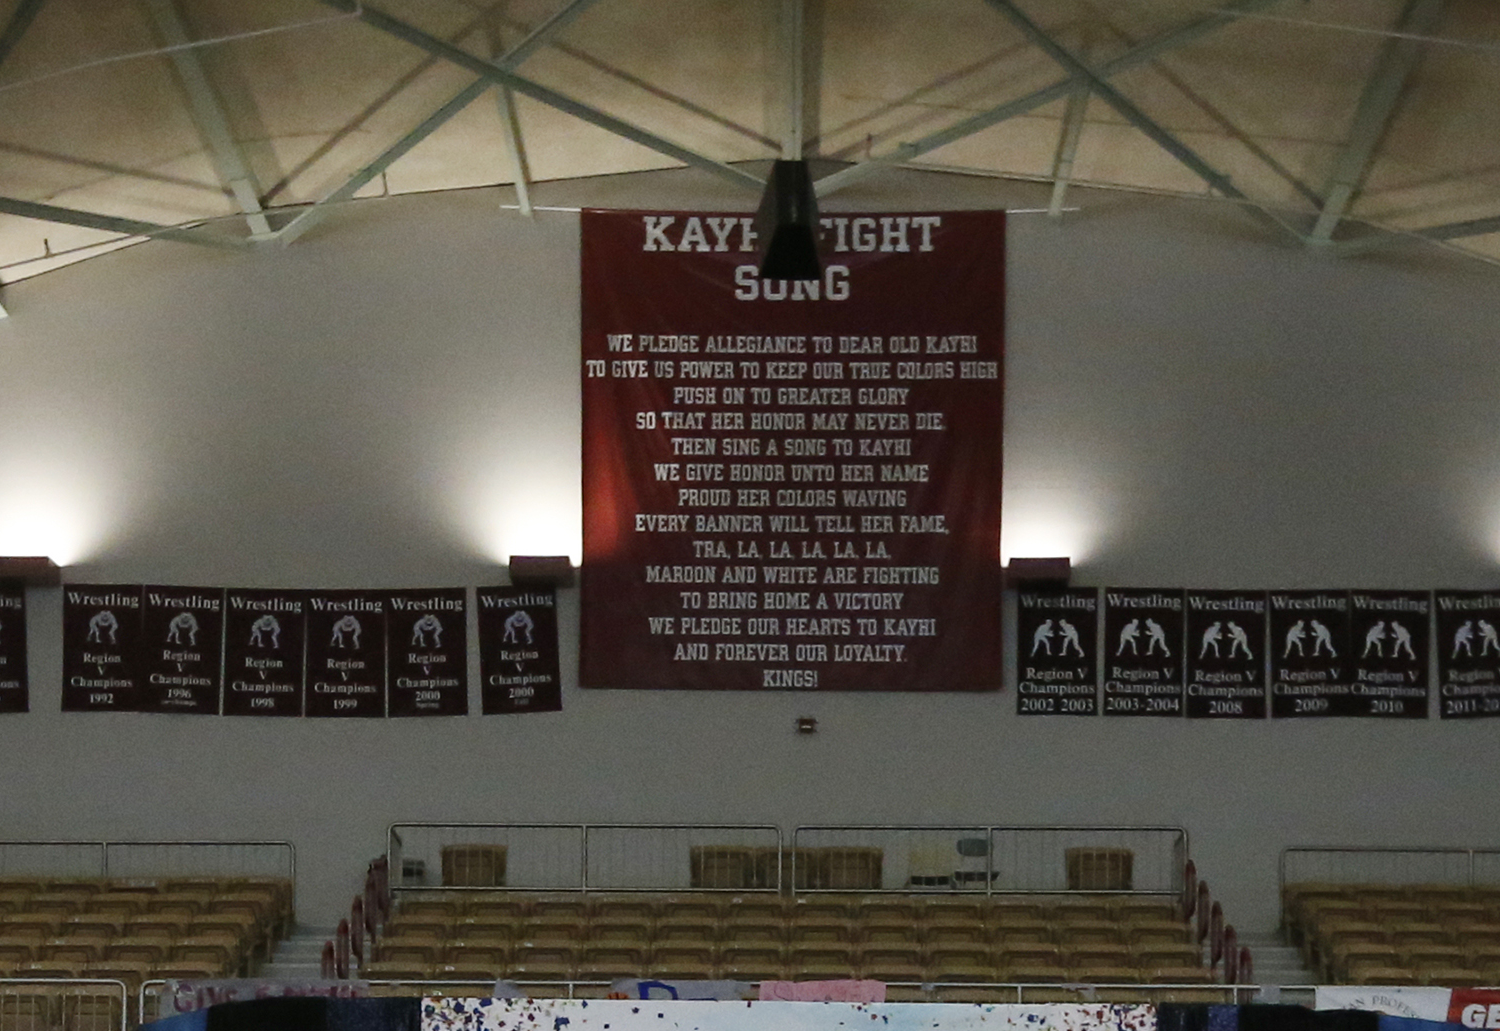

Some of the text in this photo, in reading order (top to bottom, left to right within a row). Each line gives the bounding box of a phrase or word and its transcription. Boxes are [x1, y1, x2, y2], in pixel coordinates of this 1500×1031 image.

[643, 216, 758, 251] KAYH
[607, 334, 977, 353] WE PLEDGE ALLEGIANCE TO DEAR OLD KAYHI
[587, 360, 997, 379] TO GIVE US POWER TO KEEP OUR TRUE COLORS HIGH
[674, 387, 909, 405] PUSH ON TO GREATER GLORY
[671, 438, 911, 456] THEN SING A SONG TO KAYHI
[654, 464, 929, 482] WE GIVE HONOR UNTO HER NAME
[678, 489, 906, 507] PROUD HER COLORS WAVING
[635, 514, 690, 532] EVERY
[695, 515, 763, 532] BANNER
[769, 515, 809, 532] WILL
[815, 516, 855, 532] TELL
[861, 516, 894, 532] HER
[646, 566, 939, 584] MAROON AND WHITE ARE FIGHTING
[68, 592, 139, 608] Wrestling
[231, 597, 302, 613] Wrestling
[311, 597, 382, 613] Wrestling
[680, 592, 904, 610] TO BRING HOME A VICTORY
[1021, 594, 1096, 611] Wrestling
[1107, 593, 1181, 610] Wrestling
[648, 617, 936, 636] WE PLEDGE OUR HEARTS TO KAYHI
[674, 643, 708, 660] AND
[715, 644, 789, 661] FOREVER
[796, 644, 827, 661] OUR
[763, 670, 817, 687] KINGS!
[1026, 668, 1088, 682] Region V
[415, 691, 440, 701] 2000
[1019, 682, 1095, 695] Champions
[1105, 682, 1181, 695] Champions
[1188, 684, 1264, 698] Champions
[90, 693, 114, 704] 1992
[1021, 699, 1094, 712] 2002 2003
[1107, 697, 1180, 712] 2003-2004
[1209, 701, 1243, 714] 2008
